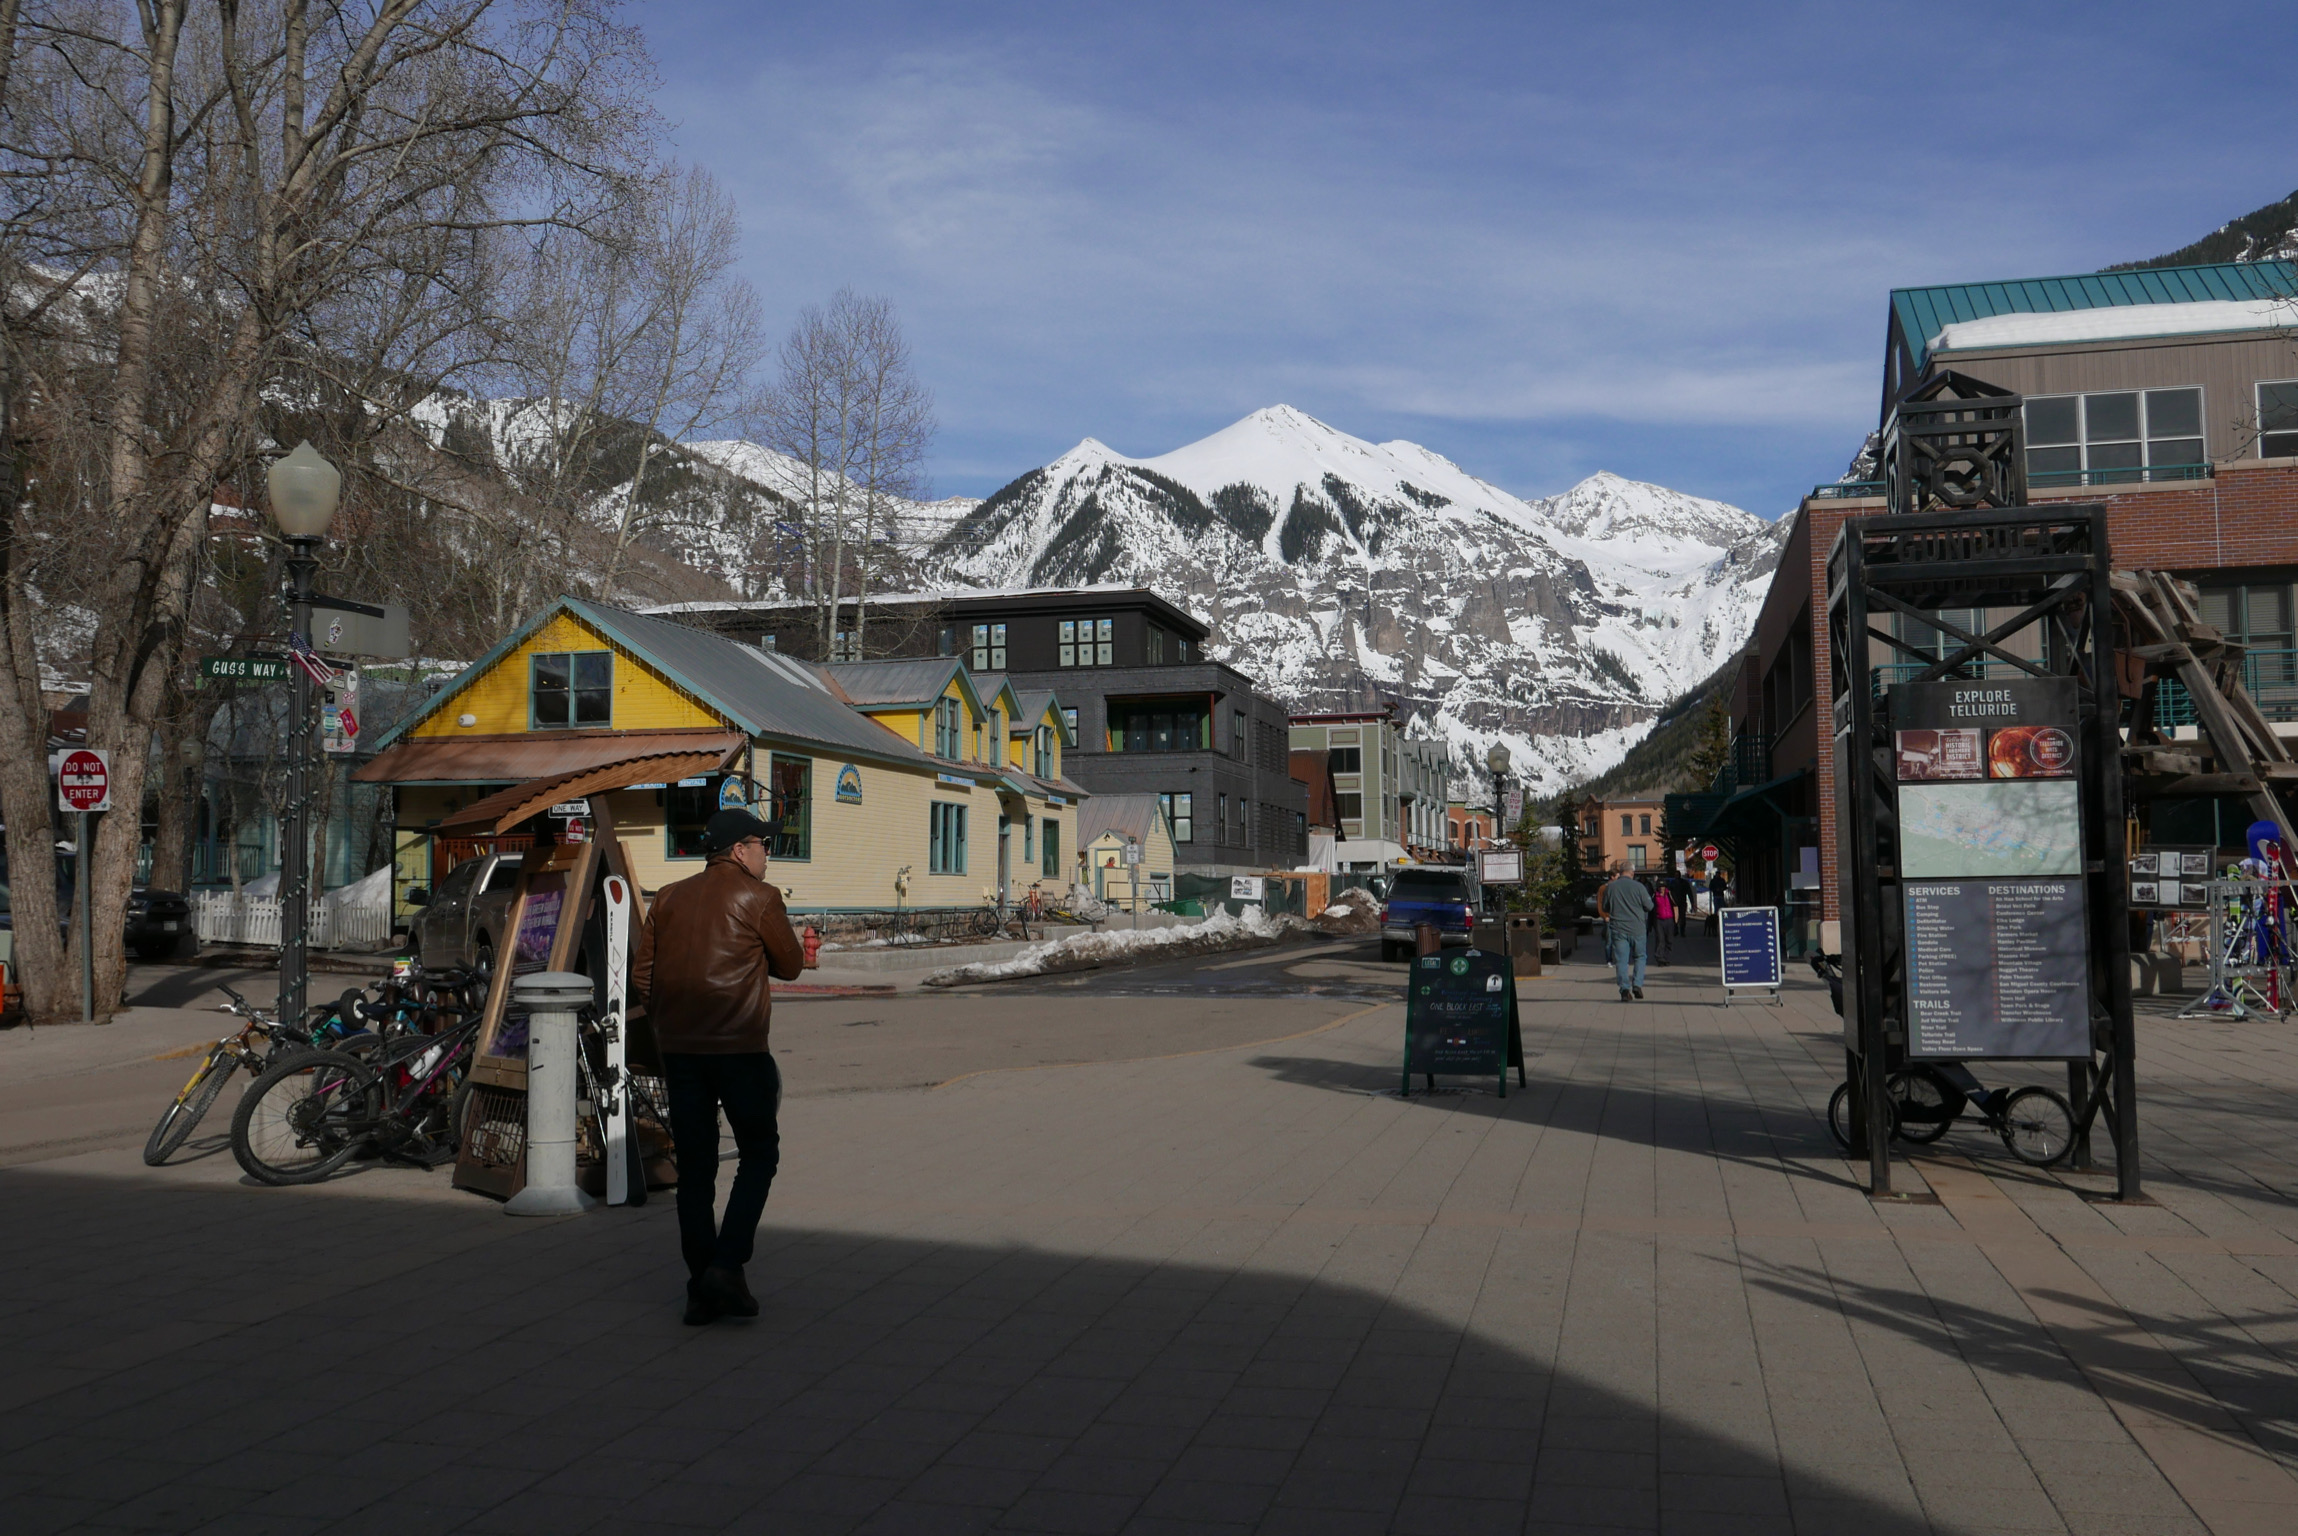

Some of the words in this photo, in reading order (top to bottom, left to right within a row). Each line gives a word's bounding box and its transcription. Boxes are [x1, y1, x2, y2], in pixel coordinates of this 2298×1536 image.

[1899, 525, 2056, 563] GONDOLA
[212, 661, 245, 676] GUS'S
[253, 663, 276, 677] WAY
[1955, 690, 2011, 704] EXPLORE
[1949, 703, 2017, 718] TELLURIDE
[65, 762, 78, 772] DO
[83, 762, 101, 772] NOT
[69, 789, 99, 799] ENTER
[554, 804, 567, 812] ONE
[1909, 887, 1960, 896] SERVICES
[1989, 885, 2066, 895] DESTINATIONS
[1429, 1002, 1442, 1010] ONE
[1446, 1002, 1467, 1011] BLOCK
[1913, 1000, 1950, 1009] TRAILS
